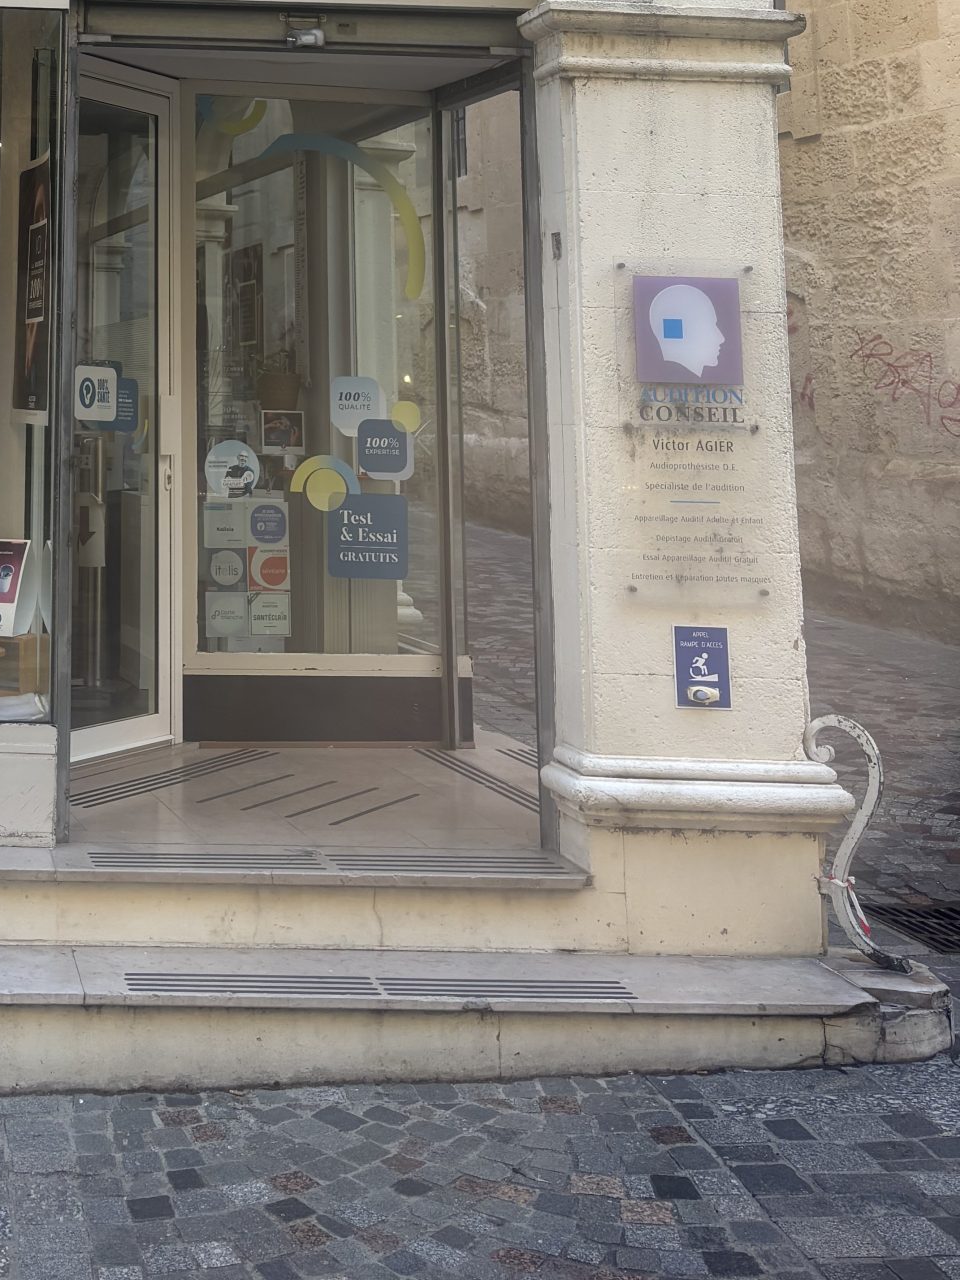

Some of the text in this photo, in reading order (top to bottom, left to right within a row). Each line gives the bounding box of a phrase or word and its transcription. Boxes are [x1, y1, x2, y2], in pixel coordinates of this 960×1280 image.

[338, 392, 371, 402] 100%
[641, 386, 744, 405] AUDITION
[640, 405, 744, 423] CONSEIL
[366, 437, 400, 448] 100%
[653, 439, 734, 452] Victor AGIER
[650, 461, 720, 471] Audioprothésiste
[645, 481, 745, 494] Spécialiste de l'audition
[340, 510, 373, 525] Test
[340, 527, 397, 543] & Essai
[340, 552, 398, 563] GRATUITS
